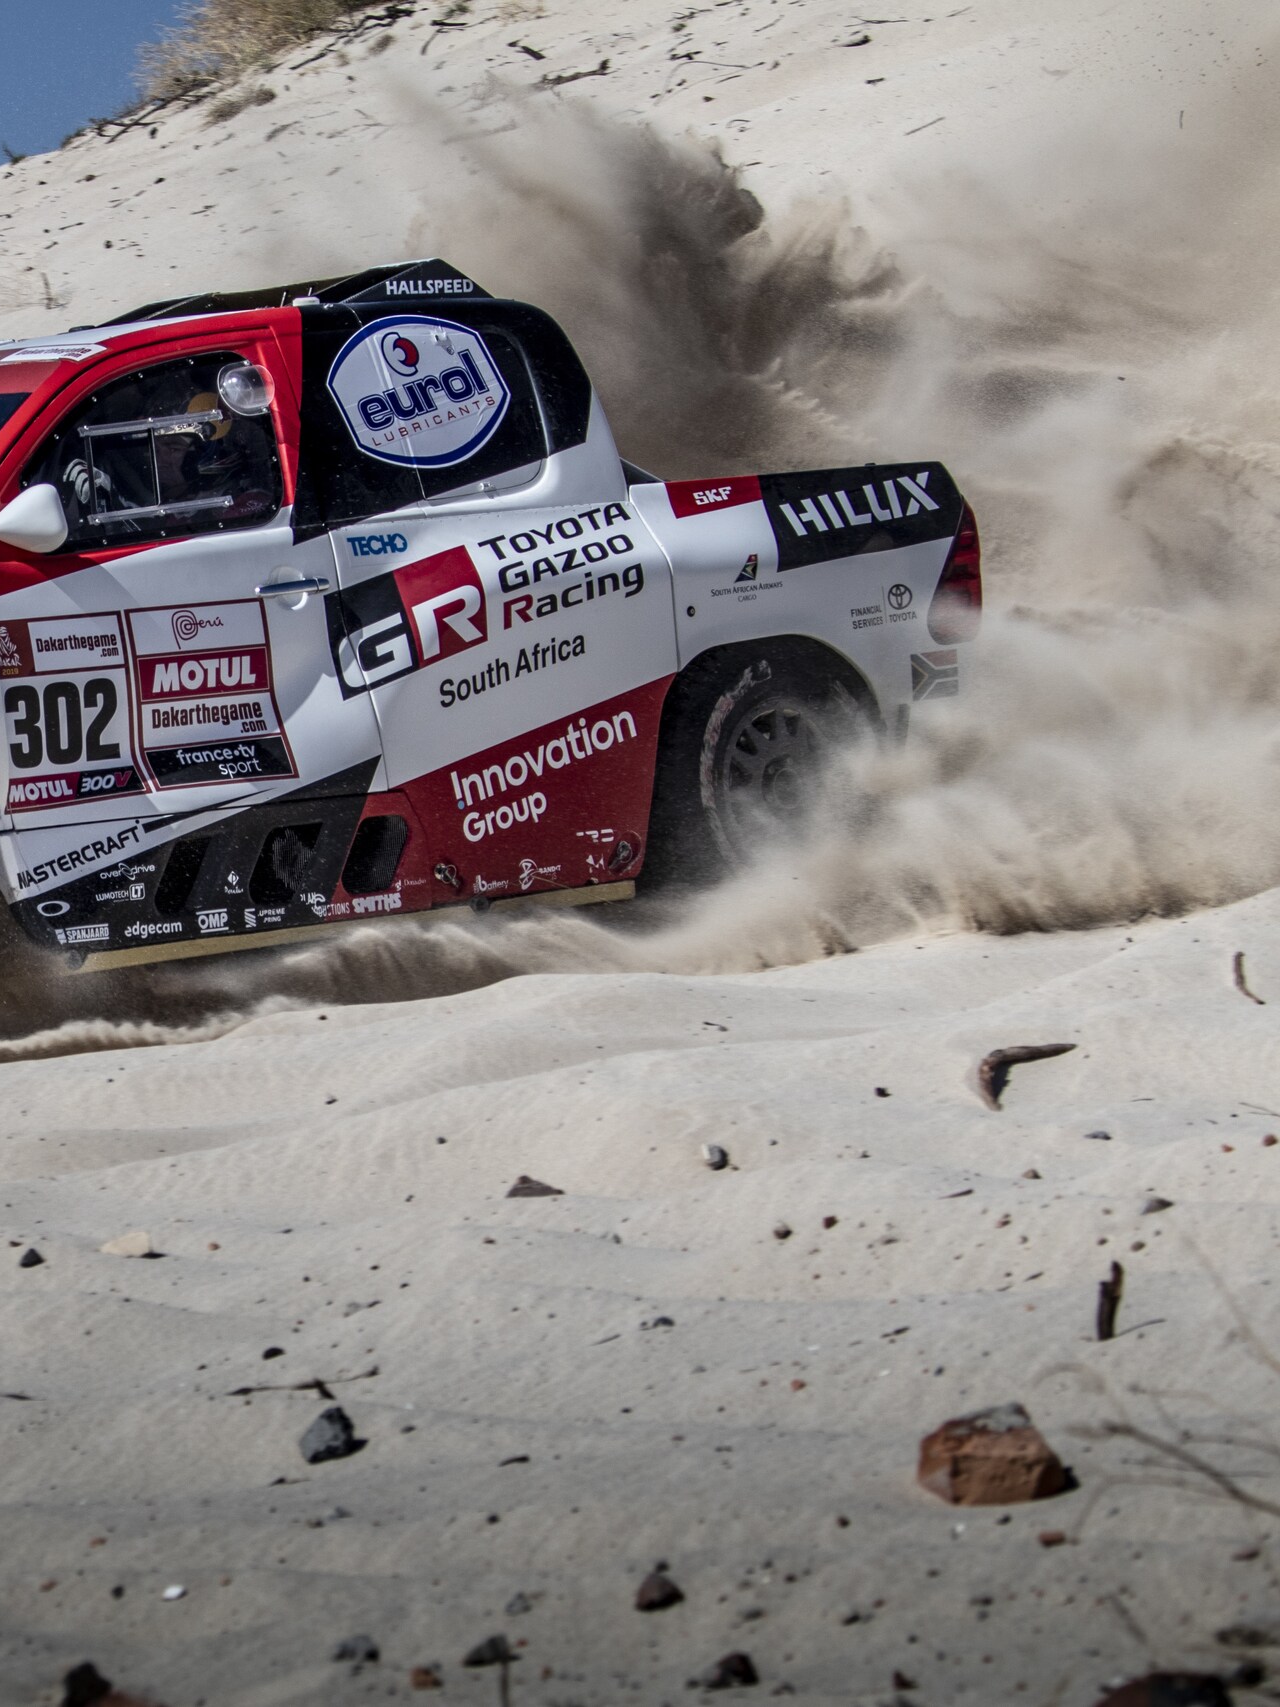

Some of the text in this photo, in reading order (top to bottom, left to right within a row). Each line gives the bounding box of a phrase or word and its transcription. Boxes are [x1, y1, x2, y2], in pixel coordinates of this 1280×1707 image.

[385, 279, 474, 295] HALLSPEED
[358, 350, 489, 432] eurol
[372, 396, 496, 447] LUBRICANTS
[693, 486, 731, 506] SKF
[779, 471, 940, 537] HILUX
[478, 502, 631, 560] TOYOTA
[346, 533, 408, 557] TECHO
[498, 534, 634, 593] GAZOO
[503, 563, 645, 630] Racing
[850, 604, 882, 618] FINANCIAL
[888, 611, 917, 624] TOYOTA
[852, 616, 883, 630] SERVICES
[36, 633, 117, 653] Dakarthegame
[338, 585, 483, 688] GR
[100, 647, 119, 658] .com
[2, 668, 19, 676] 2019
[152, 656, 257, 694] MOTUL
[440, 634, 586, 708] South Africa
[4, 678, 121, 769] 302
[152, 702, 263, 729] Dakarthegame
[240, 719, 267, 733] .com
[219, 759, 262, 779] sport
[450, 711, 638, 810] Innovation
[9, 770, 133, 803] MOTUL 300V
[463, 791, 548, 842] Group
[96, 890, 129, 901] LUMOTECH
[352, 893, 402, 913] SMITHS
[197, 912, 229, 930] OMP
[258, 908, 286, 917] UPREME
[67, 927, 110, 941] SPANJAARD
[124, 921, 182, 939] edgecam
